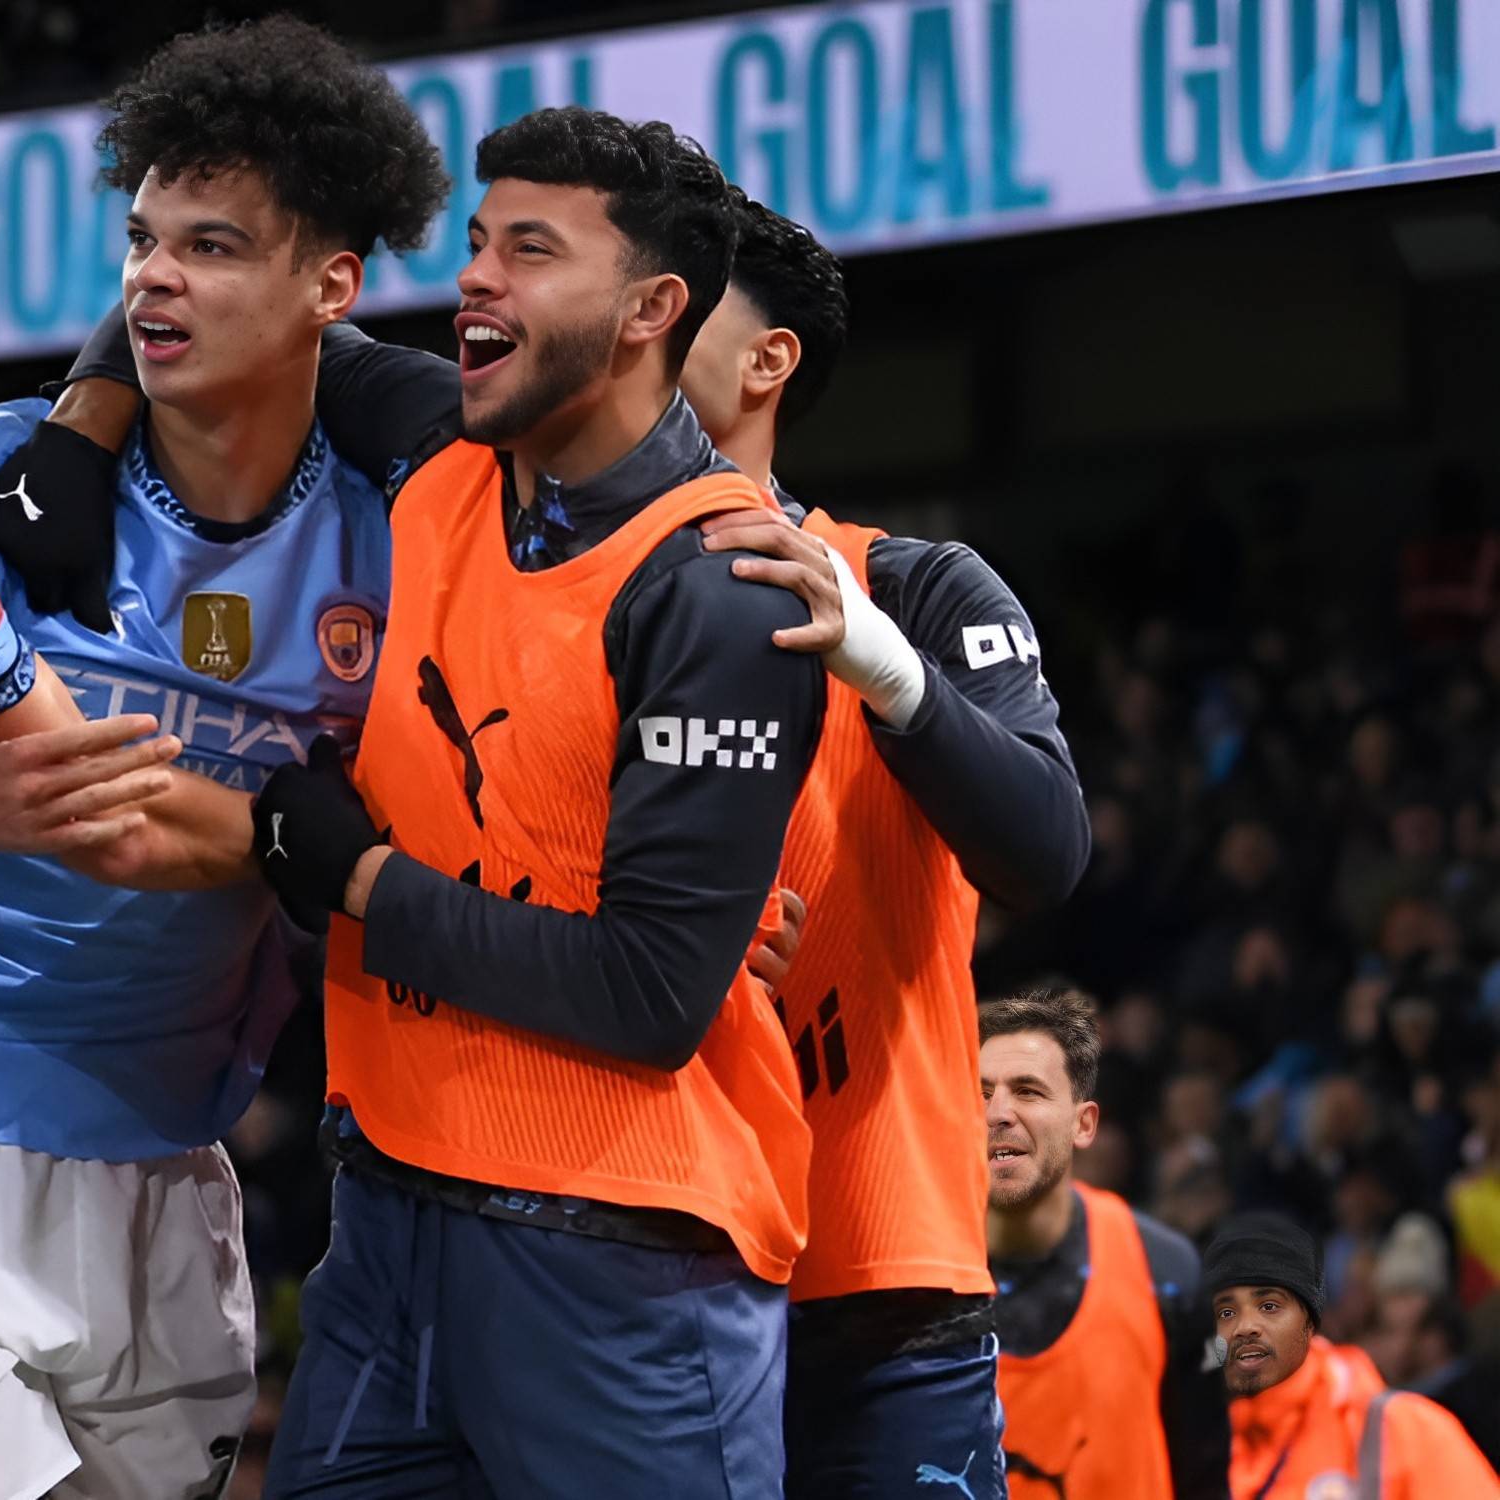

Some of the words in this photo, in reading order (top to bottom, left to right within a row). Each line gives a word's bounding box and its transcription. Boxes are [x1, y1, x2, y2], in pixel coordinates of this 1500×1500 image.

[714, 0, 1051, 233] GOAL
[1141, 0, 1497, 191] GOAL
[962, 623, 1041, 671] OK
[638, 716, 780, 770] OKX
